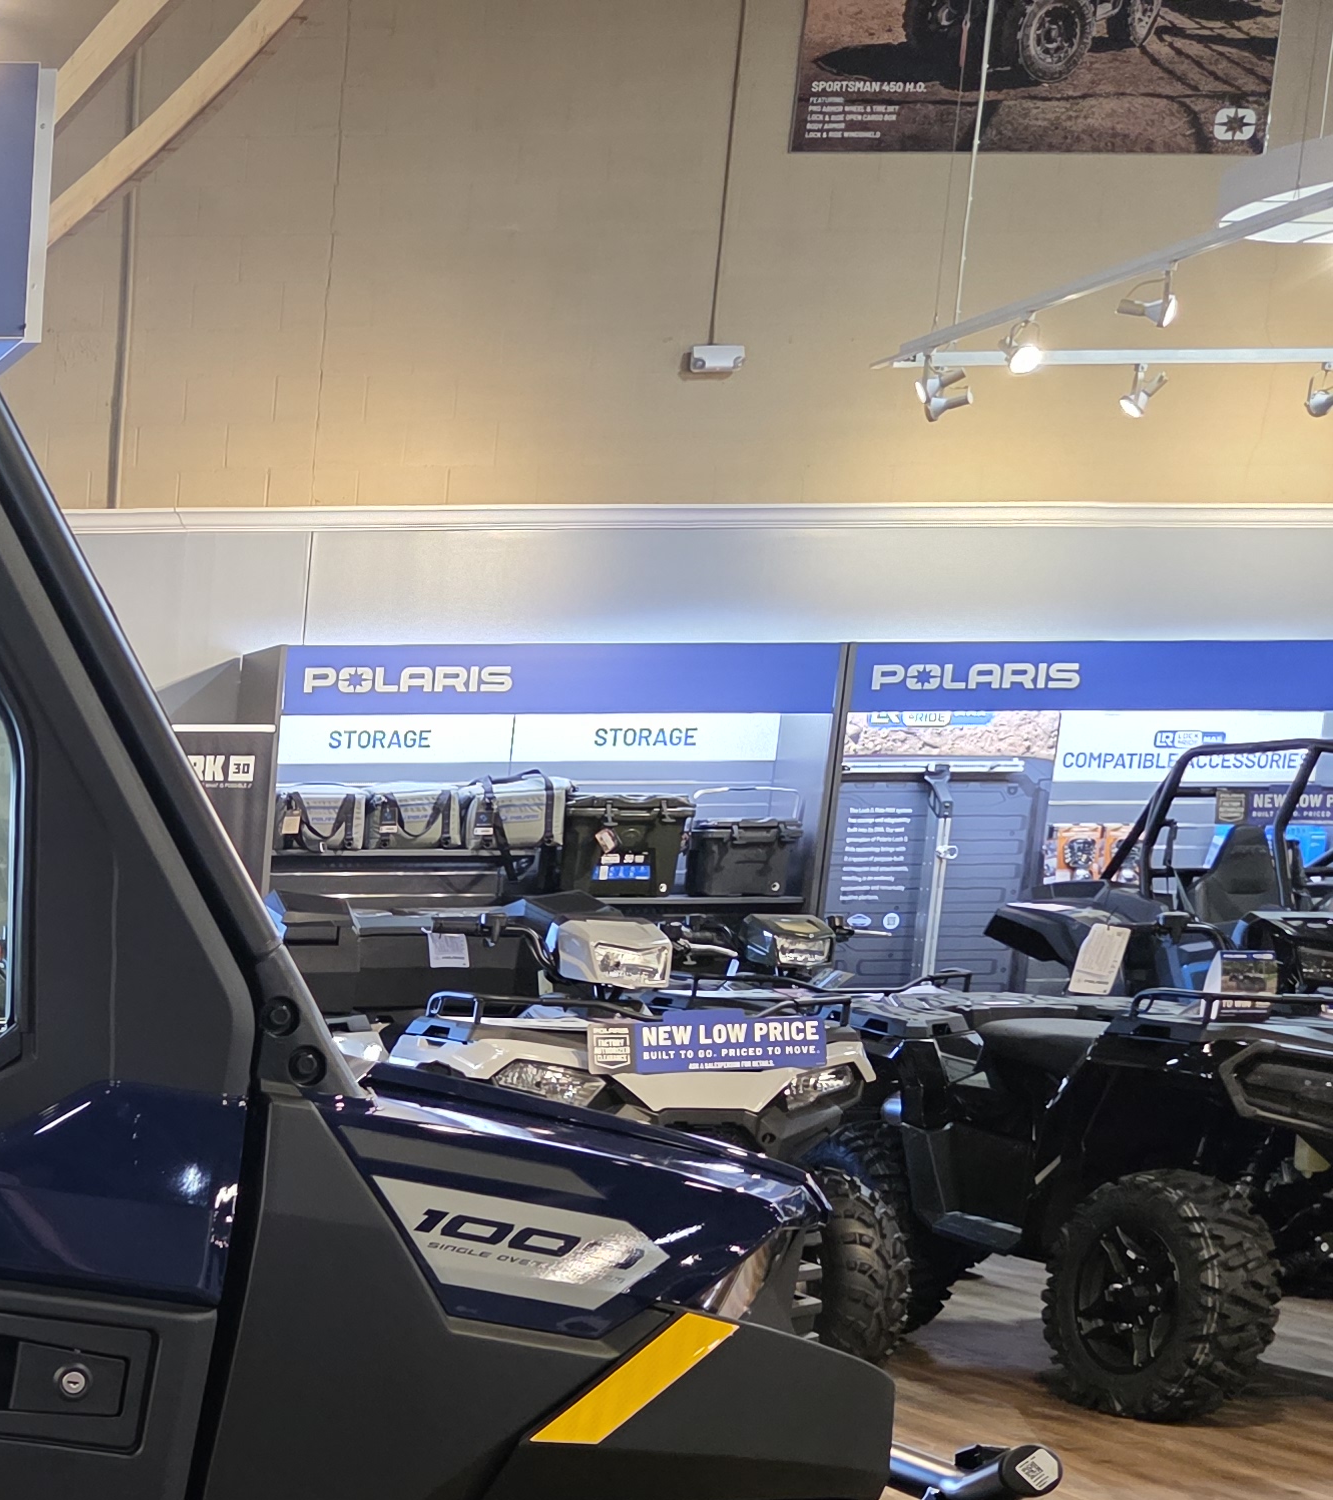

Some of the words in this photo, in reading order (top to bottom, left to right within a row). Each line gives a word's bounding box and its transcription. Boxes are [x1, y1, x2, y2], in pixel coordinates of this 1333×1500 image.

[811, 81, 880, 92] SPORTSMAN
[881, 81, 904, 92] 450
[905, 82, 927, 92] H.O.
[302, 665, 513, 694] POLARIS
[871, 662, 1081, 691] POLARIS
[327, 729, 432, 750] STORAGE
[593, 727, 699, 748] STORAGE
[233, 763, 251, 774] 30
[1062, 752, 1178, 770] COMPATIBLE
[1253, 794, 1288, 808] NEW
[1296, 794, 1323, 808] OW
[642, 1025, 693, 1046] NEW
[699, 1023, 748, 1045] LOW
[754, 1020, 820, 1042] PRICE
[642, 1050, 675, 1060] BUILT
[680, 1050, 693, 1059] TO
[721, 1047, 763, 1057] PRICED
[766, 1046, 782, 1055] TO
[785, 1045, 820, 1054] MOVE.
[427, 1241, 493, 1258] SINGLE
